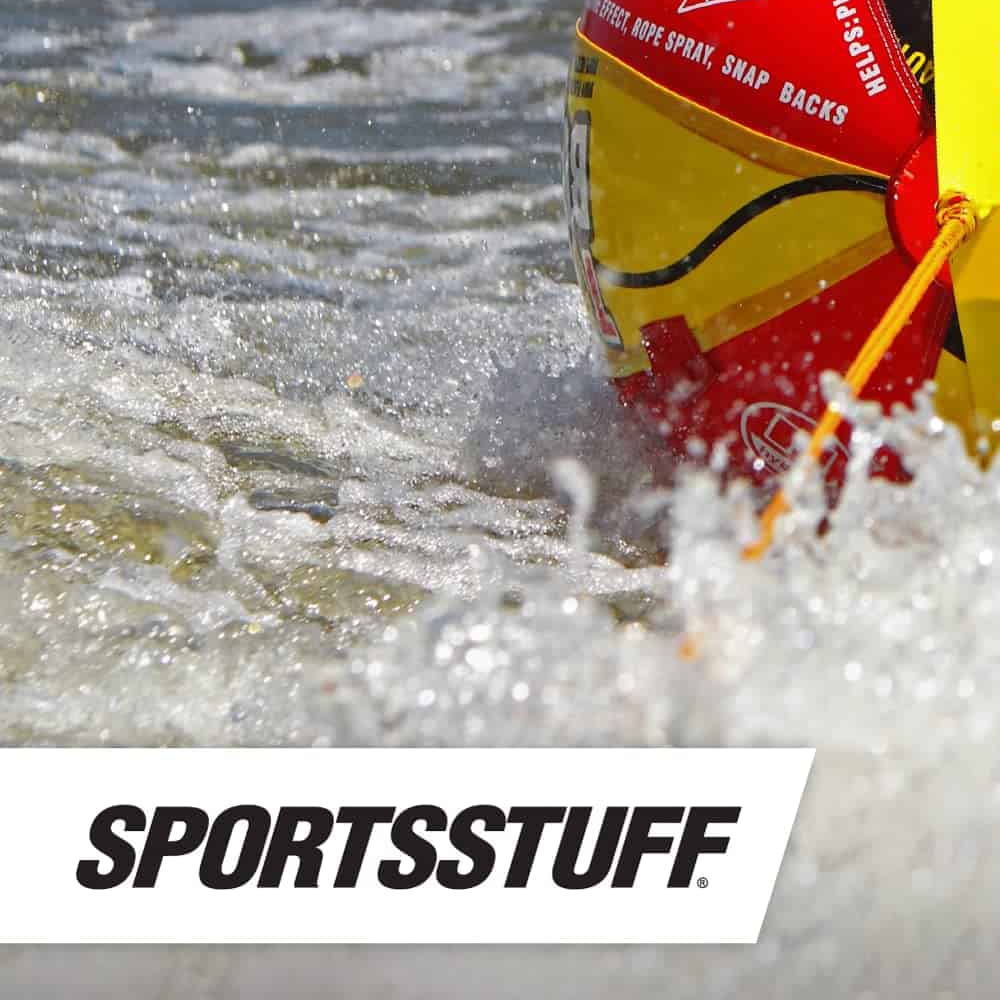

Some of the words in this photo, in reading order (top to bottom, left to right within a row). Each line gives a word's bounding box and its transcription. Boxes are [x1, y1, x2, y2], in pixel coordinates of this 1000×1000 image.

[630, 17, 664, 47] ROPE
[664, 31, 715, 71] SPRAY,
[721, 54, 770, 90] SNAP
[779, 81, 849, 126] BACKS
